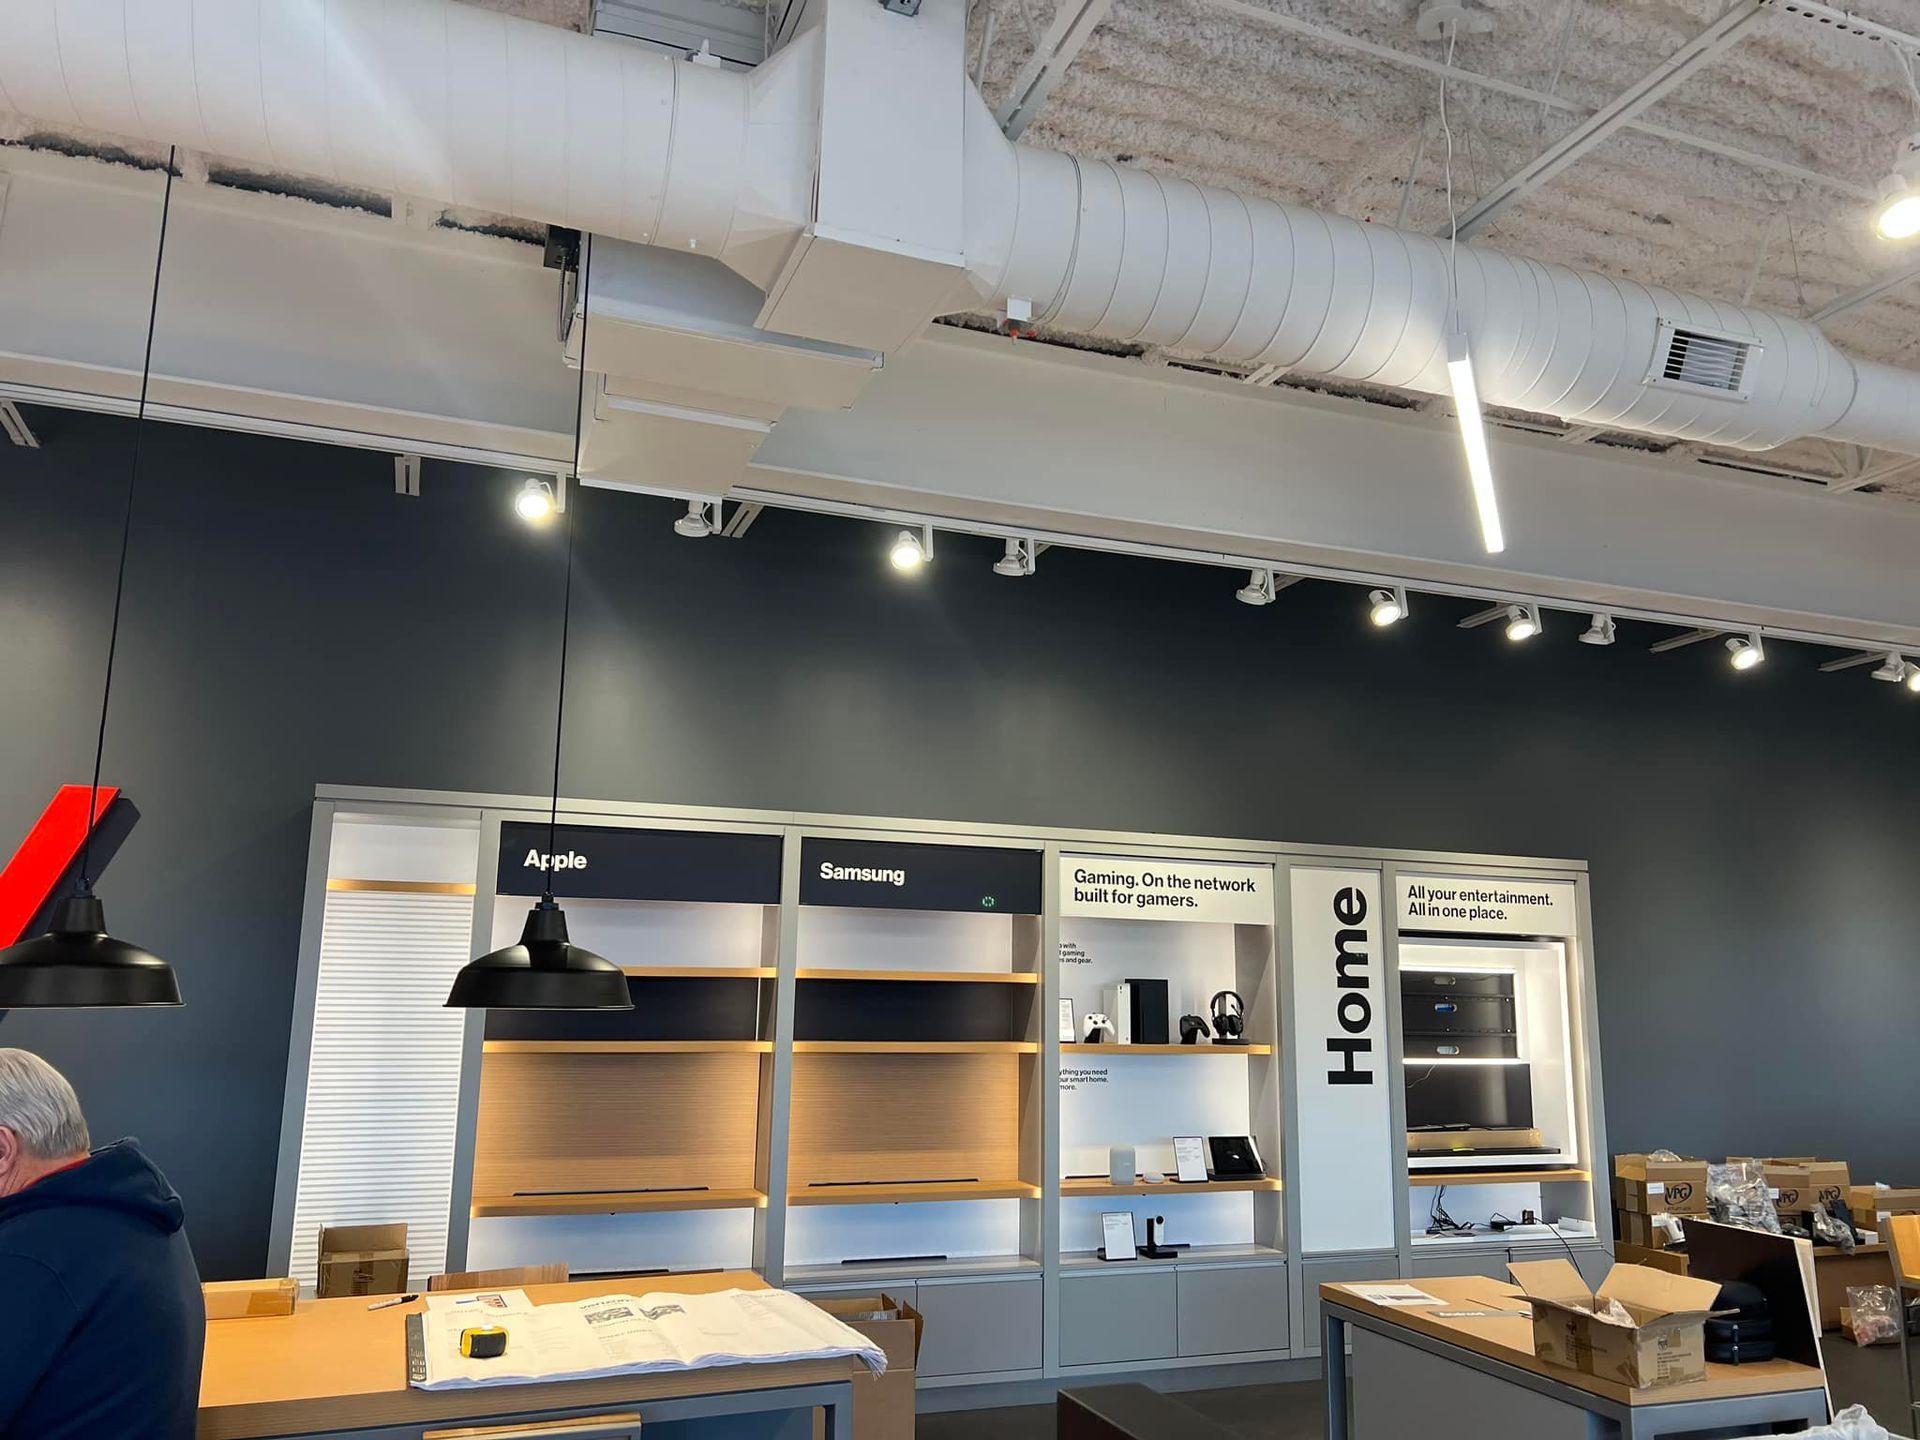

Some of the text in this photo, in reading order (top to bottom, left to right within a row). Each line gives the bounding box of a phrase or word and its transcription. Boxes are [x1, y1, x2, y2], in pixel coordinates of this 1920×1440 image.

[523, 849, 587, 872] Apple
[820, 862, 905, 886] Samsung
[1074, 869, 1256, 892] Gaming. On the network
[1074, 888, 1198, 908] built for gamers.
[1408, 885, 1553, 906] All your entertainment.
[1408, 902, 1508, 921] All in one place.
[1326, 886, 1373, 1085] Home
